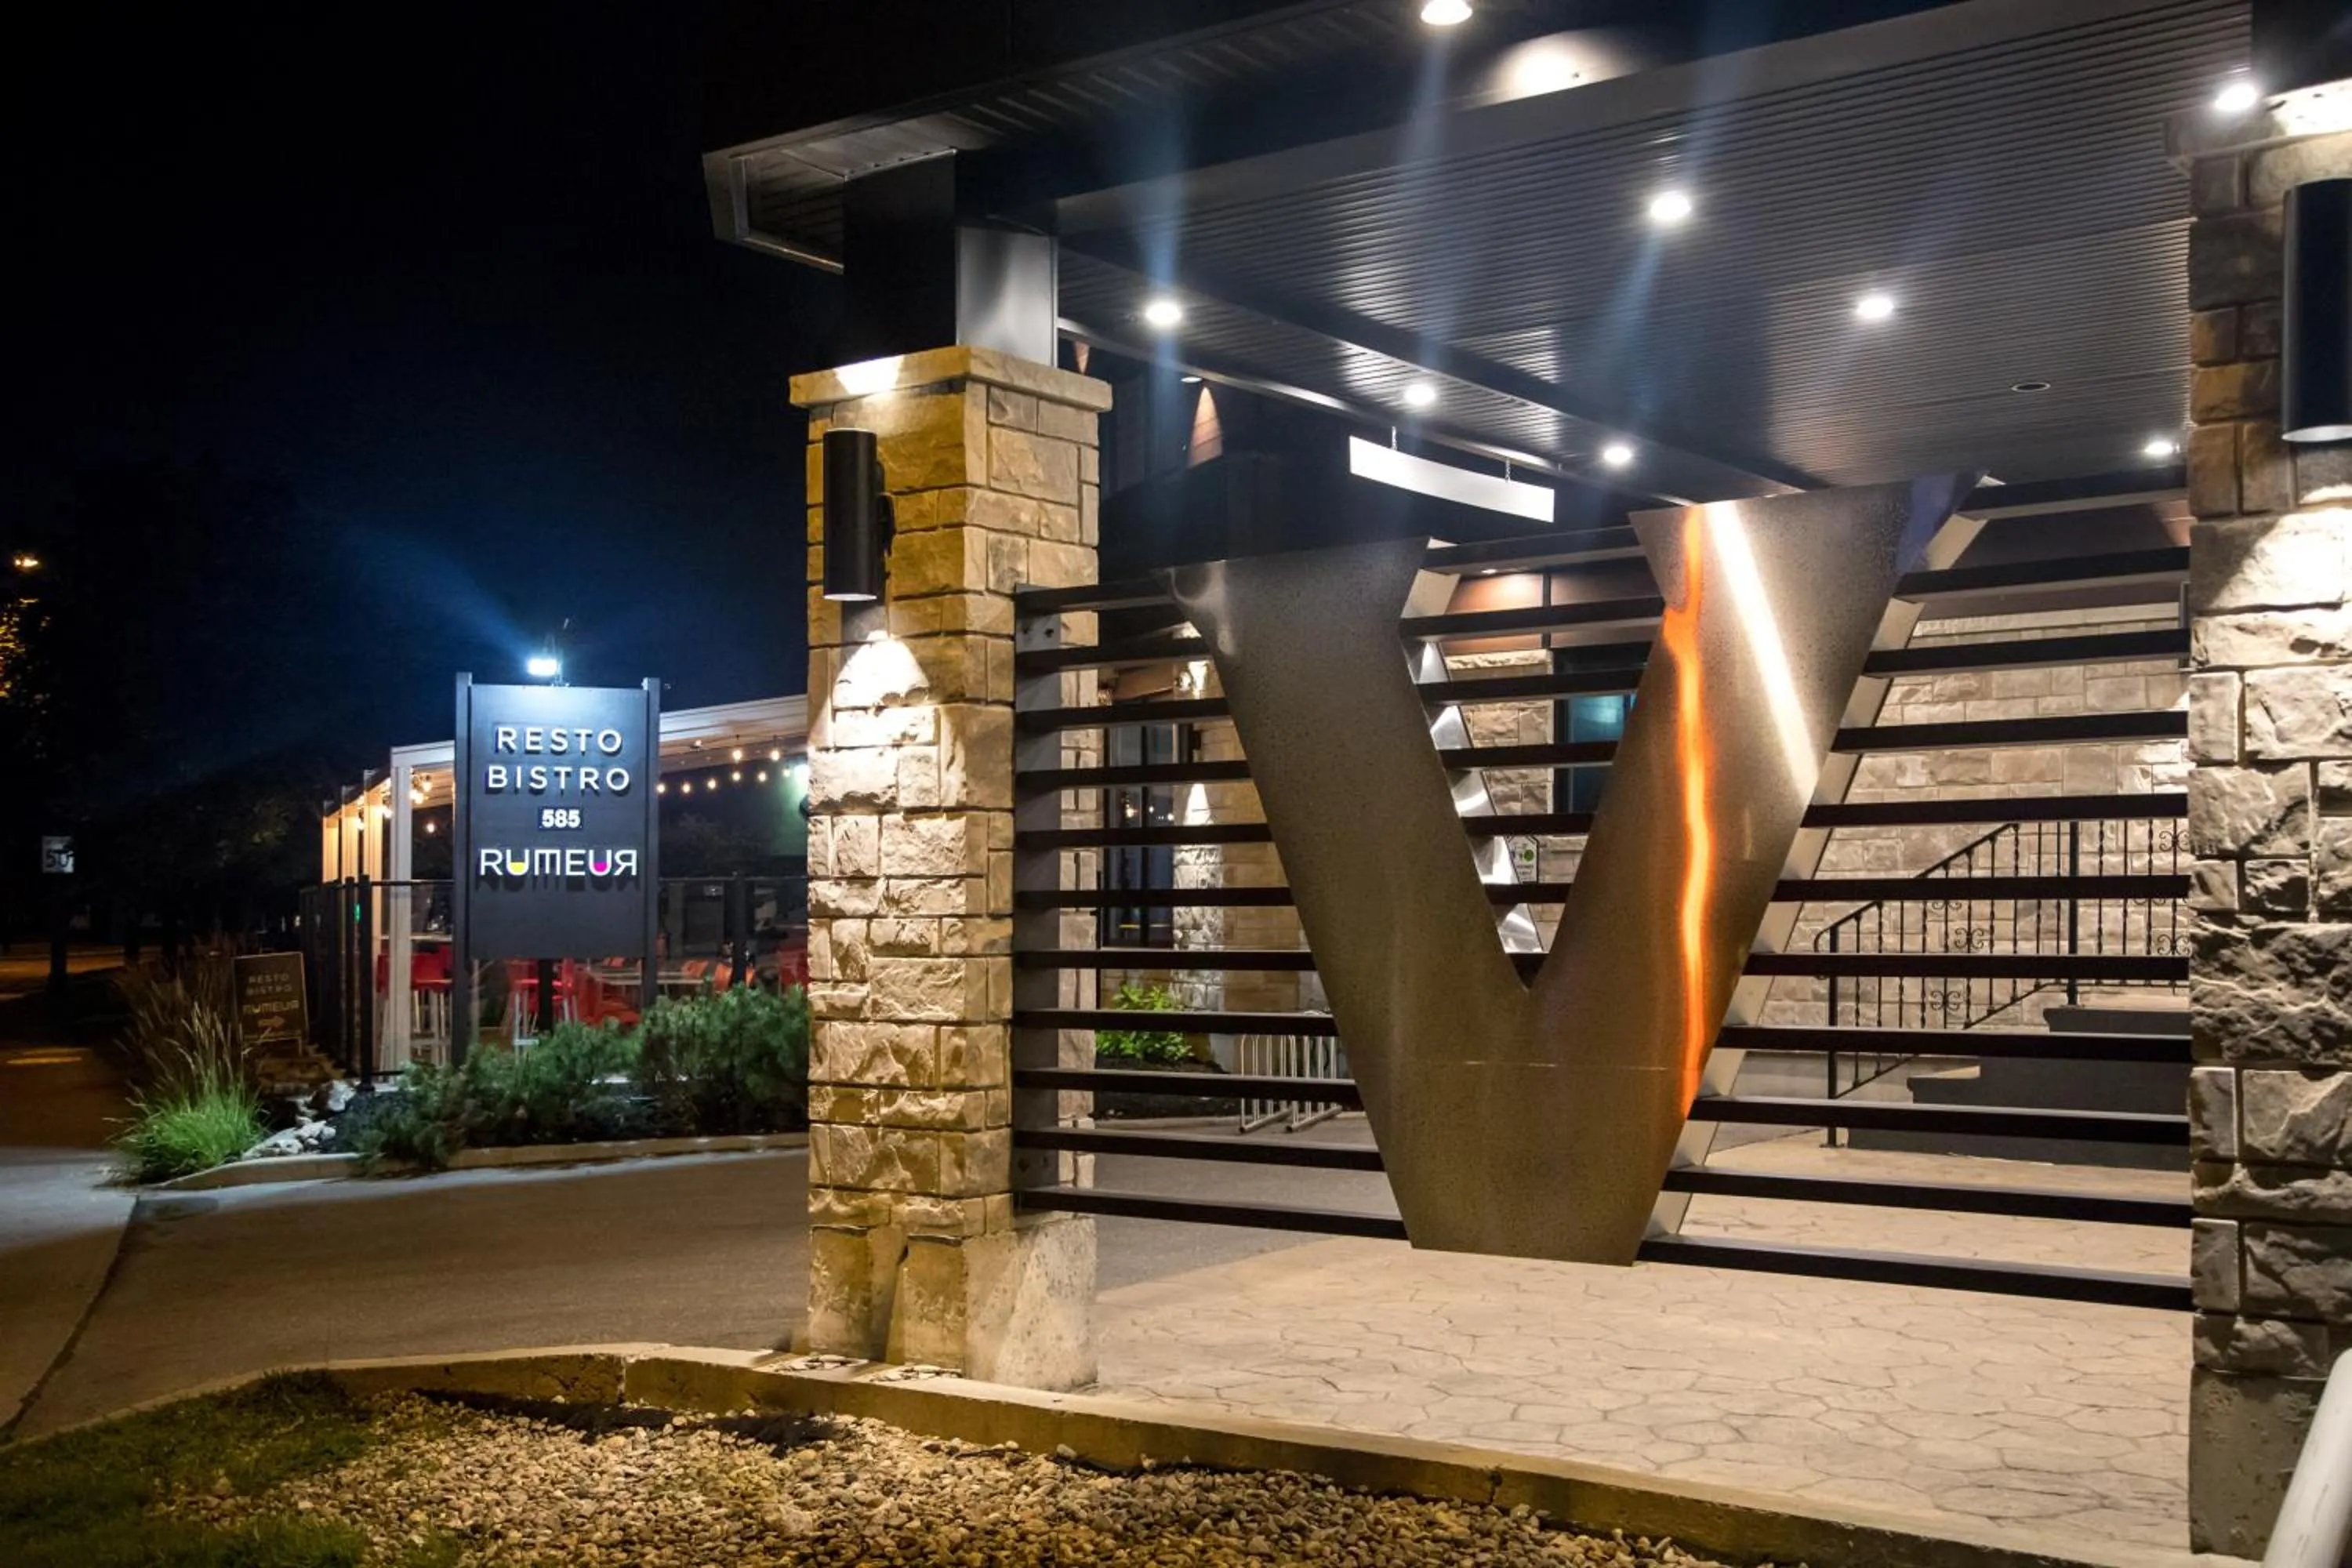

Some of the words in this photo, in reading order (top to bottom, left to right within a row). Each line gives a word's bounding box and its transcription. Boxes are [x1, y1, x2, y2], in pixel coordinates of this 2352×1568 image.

[496, 727, 622, 753] RESTO
[487, 765, 630, 791] BISTRO
[541, 809, 581, 829] 585
